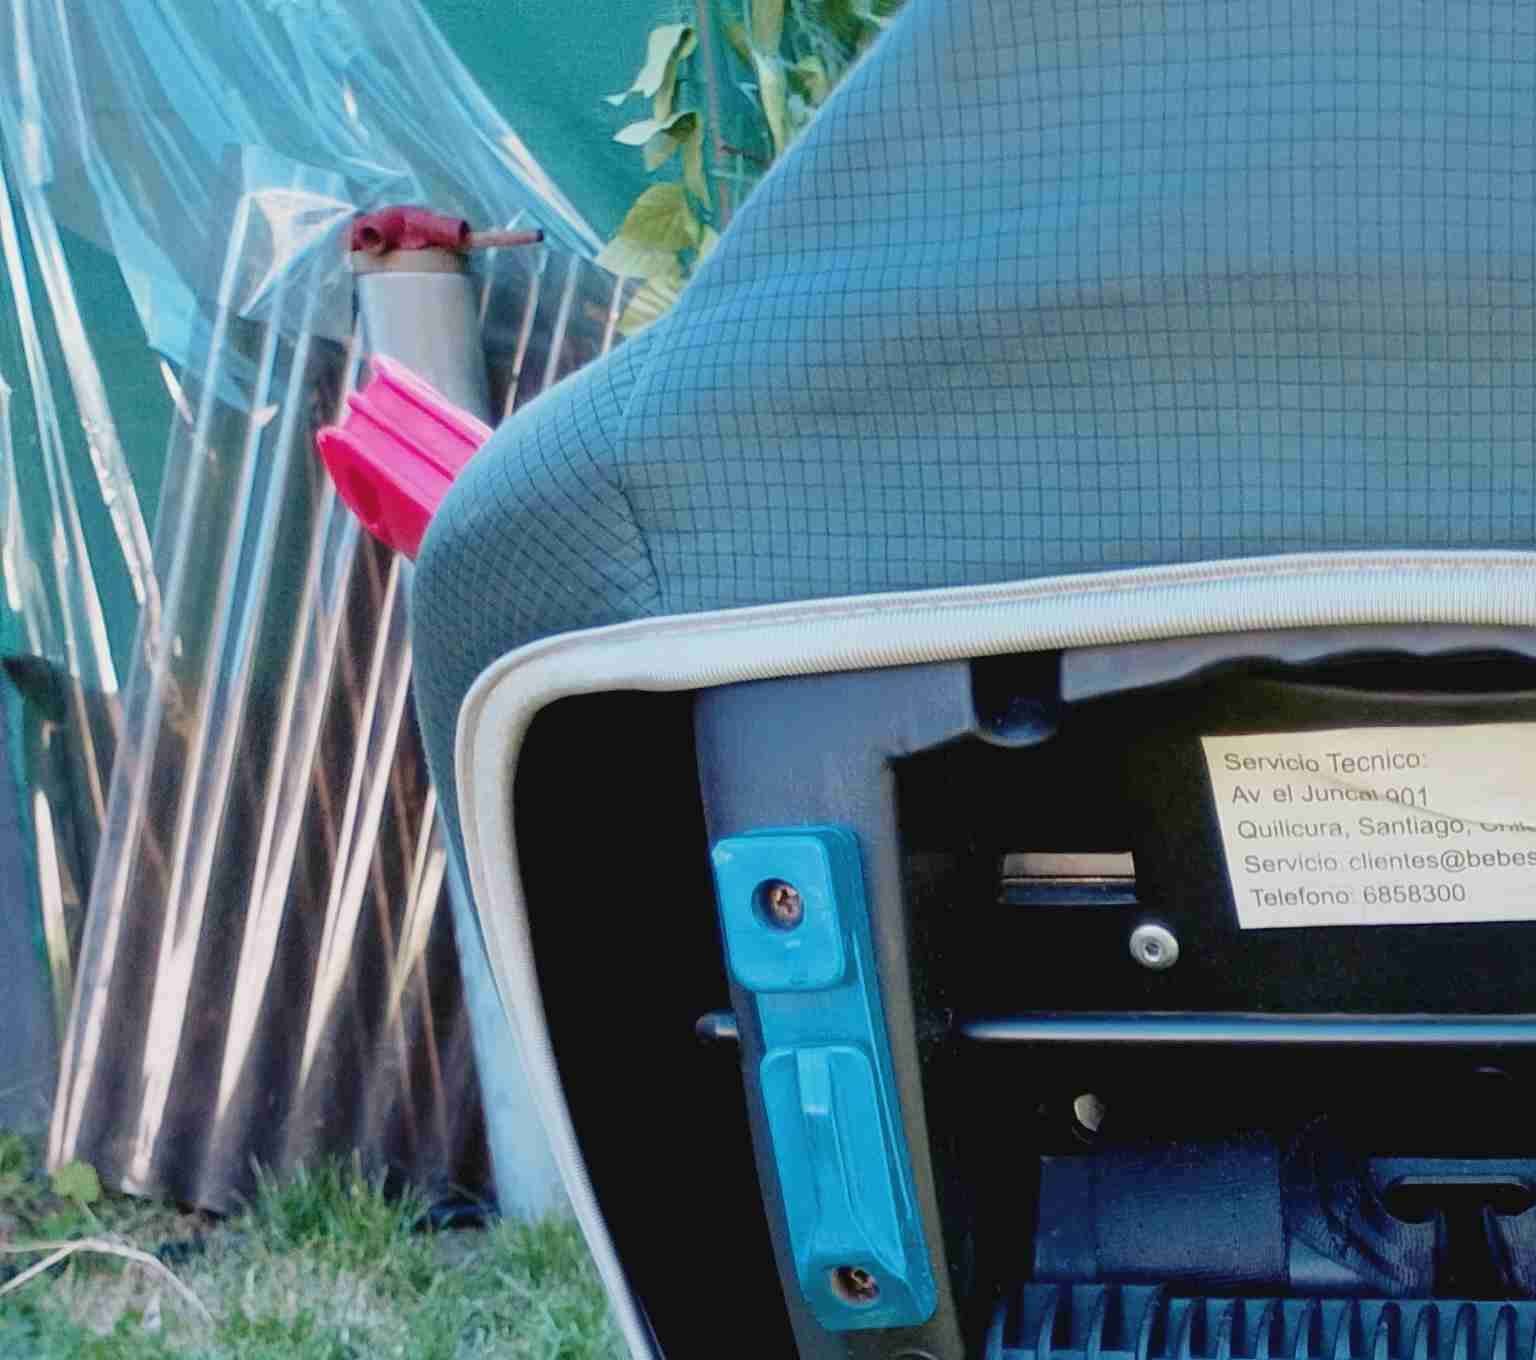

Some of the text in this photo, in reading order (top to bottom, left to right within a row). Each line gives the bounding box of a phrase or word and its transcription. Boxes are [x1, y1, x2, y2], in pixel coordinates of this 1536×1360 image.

[1224, 753, 1320, 773] Servicio
[1232, 784, 1261, 803] Av
[1273, 783, 1293, 802] el
[1385, 786, 1429, 808] 901
[1238, 818, 1350, 839] Quilicura,
[1358, 816, 1472, 839] Santiago,
[1363, 883, 1466, 905] 6858300
